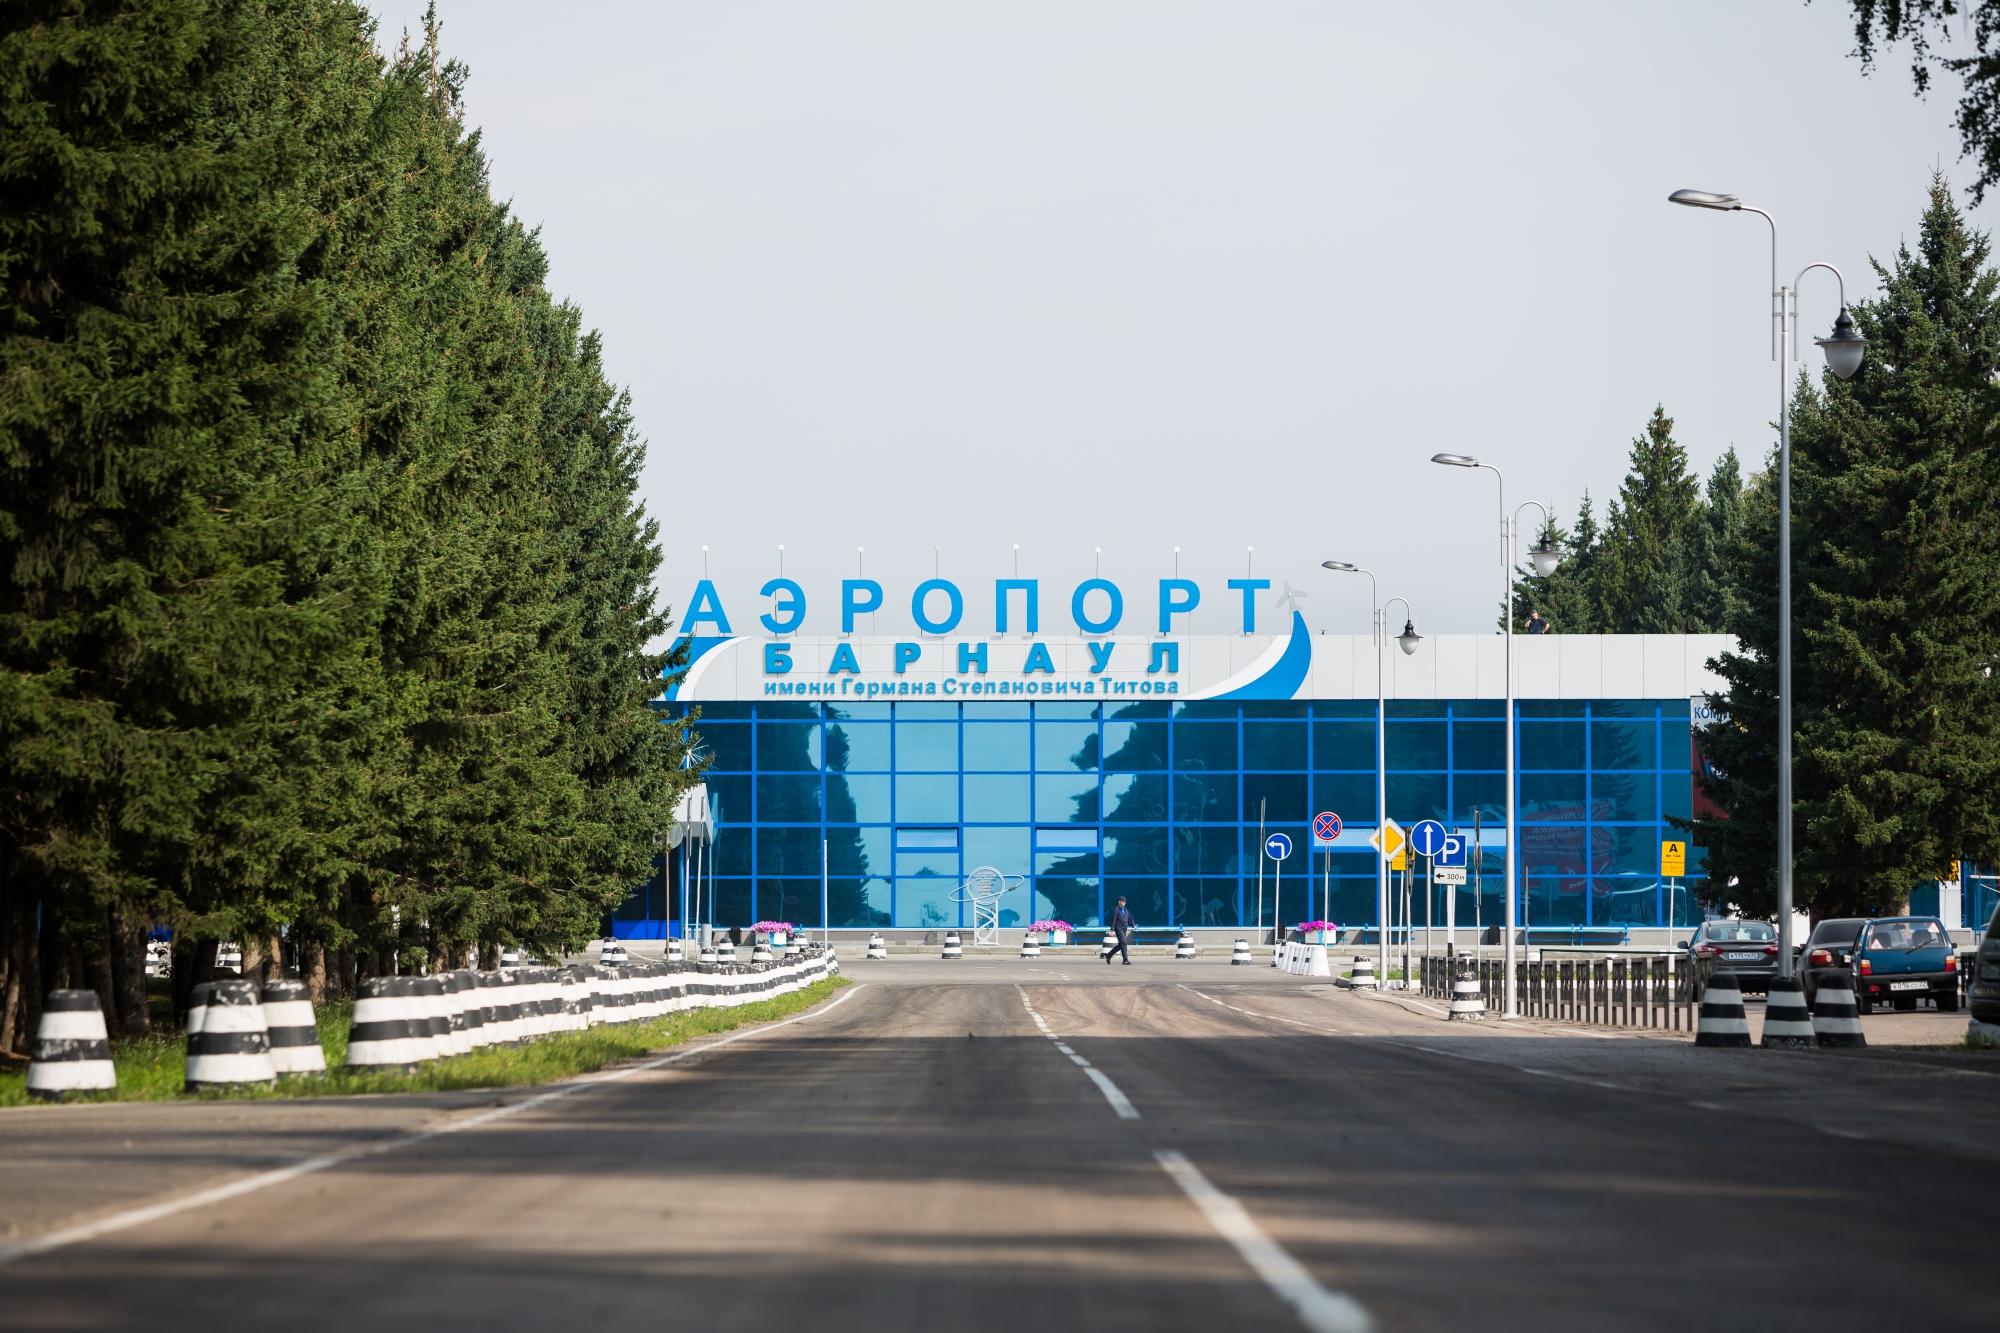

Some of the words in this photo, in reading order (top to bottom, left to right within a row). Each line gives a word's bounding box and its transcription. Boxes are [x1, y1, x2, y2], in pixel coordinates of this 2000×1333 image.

[680, 578, 1271, 635] АЭРОПОРТ
[764, 641, 1179, 675] БАРНАУЛ
[764, 682, 836, 696] имени
[842, 680, 937, 699] Германа
[943, 678, 1096, 697] Степановича
[1101, 676, 1180, 695] Титова
[1442, 838, 1460, 864] P
